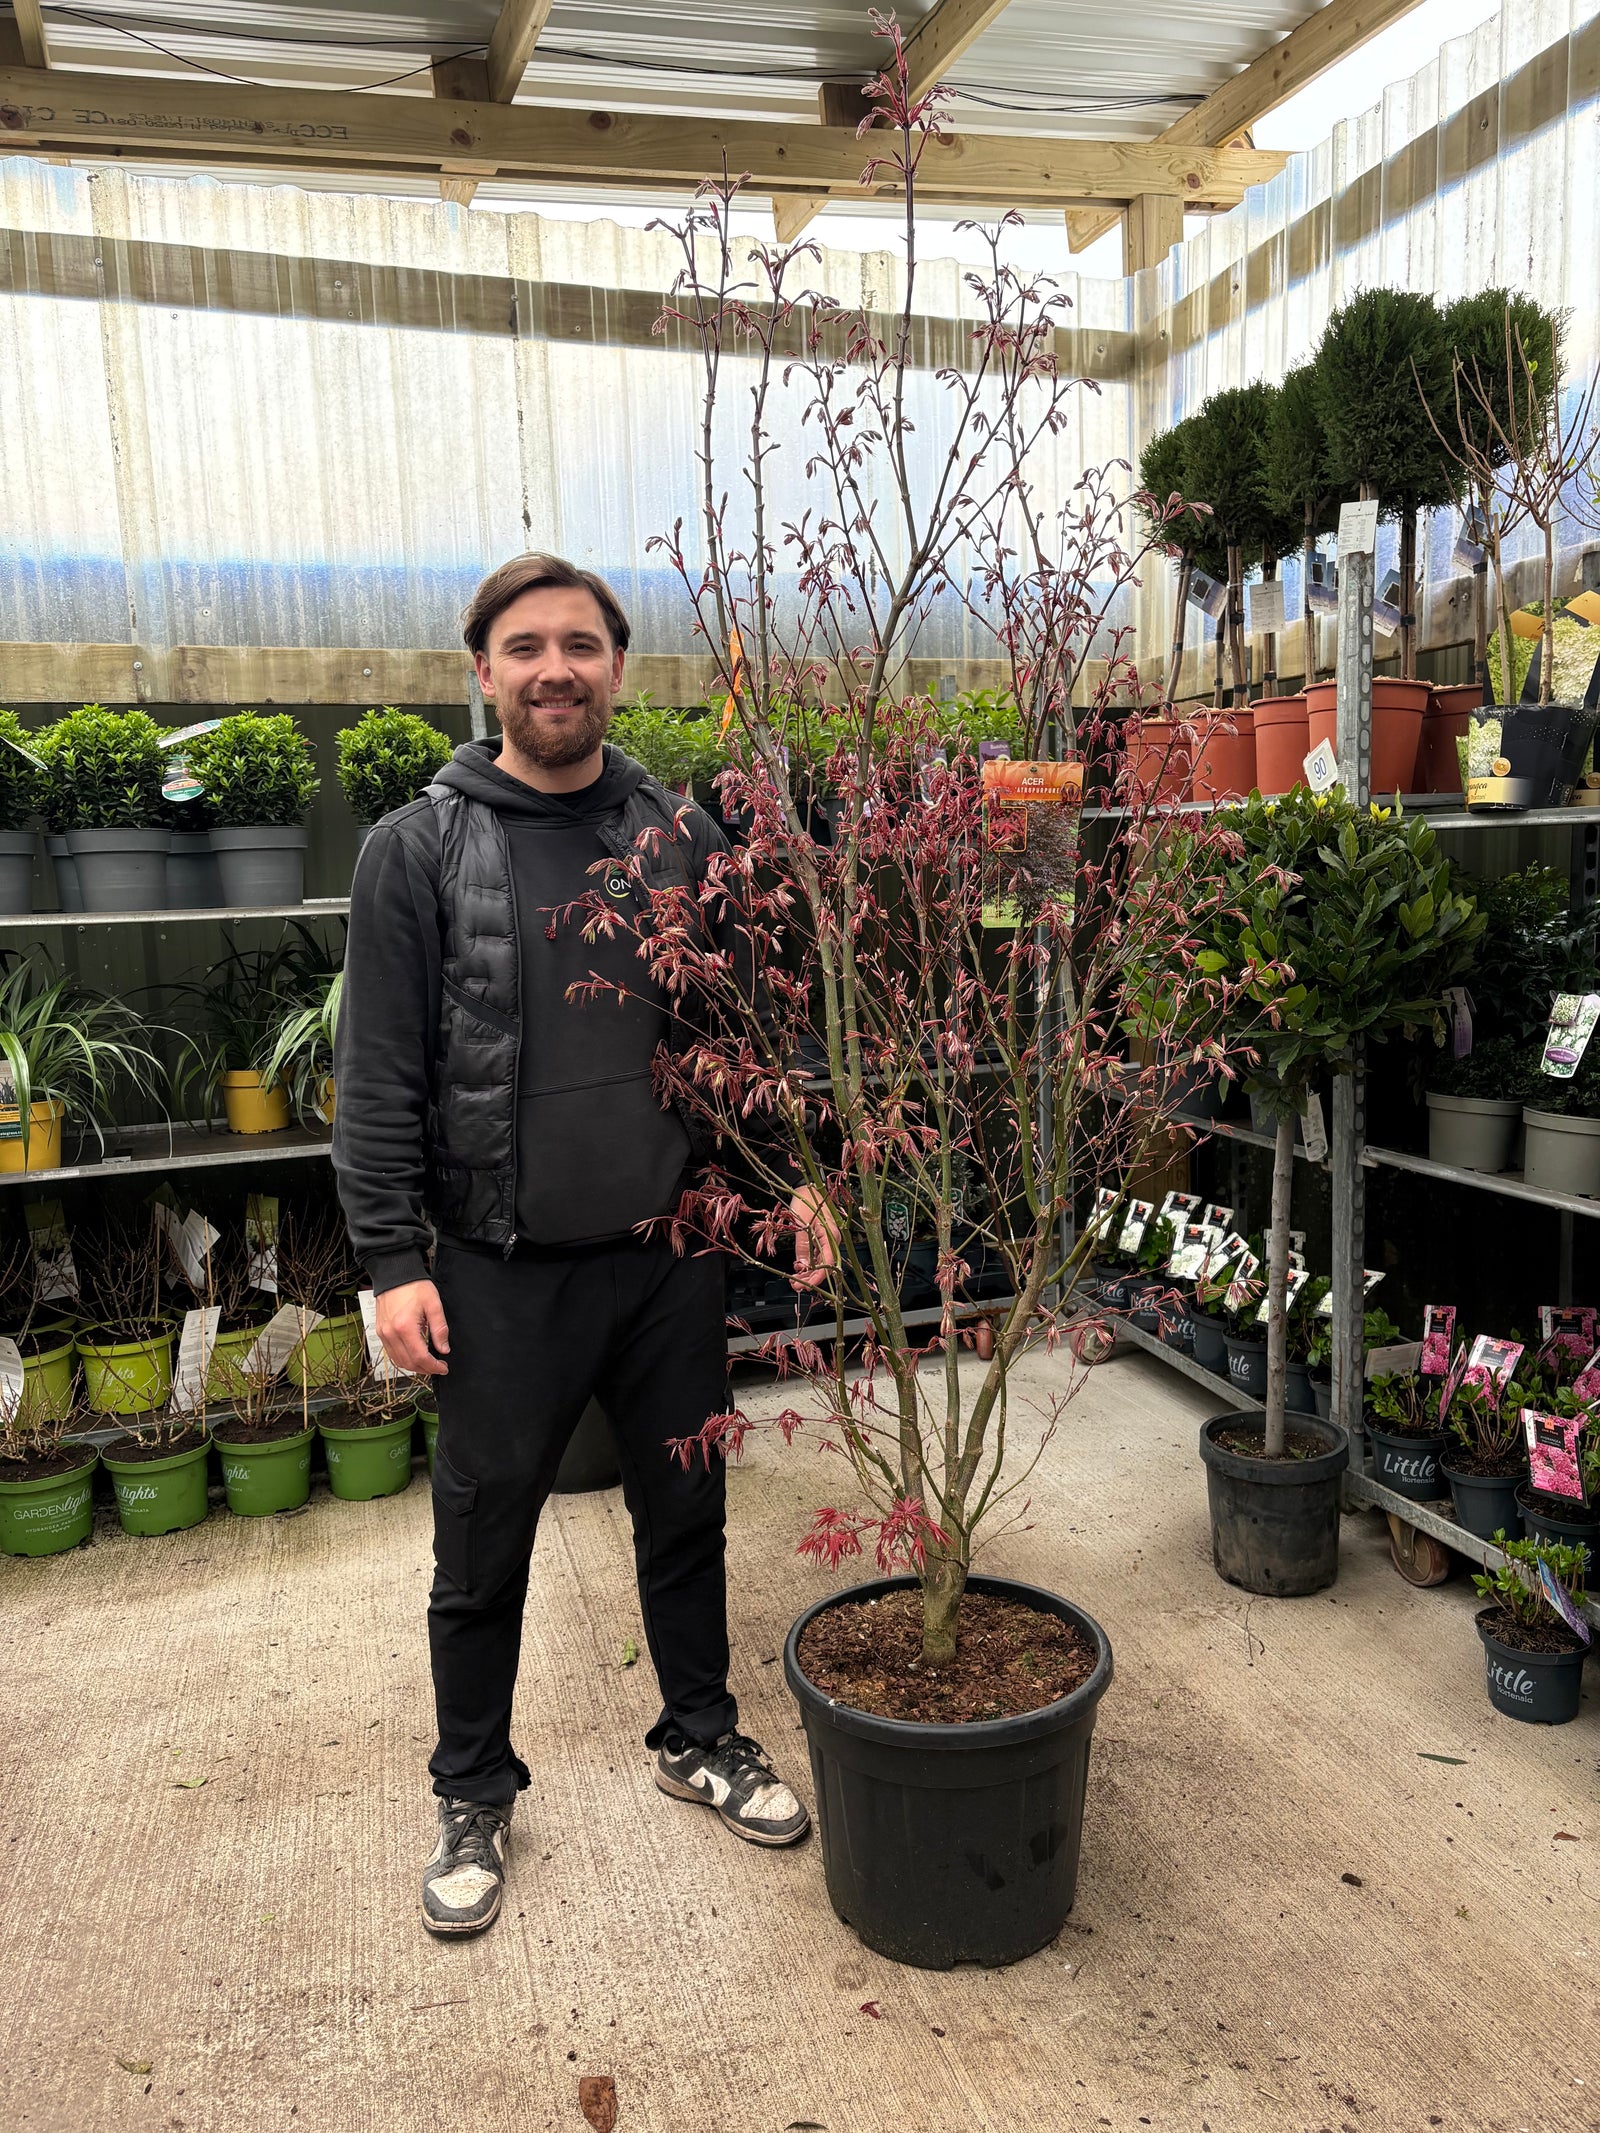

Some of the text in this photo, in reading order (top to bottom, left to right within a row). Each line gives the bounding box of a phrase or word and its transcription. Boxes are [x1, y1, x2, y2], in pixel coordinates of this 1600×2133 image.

[72, 108, 109, 124] CE
[299, 124, 350, 140] ECC
[1314, 757, 1327, 780] 90
[1021, 777, 1045, 786] ACER
[1383, 1453, 1437, 1479] Little
[1402, 1474, 1435, 1484] Hortensia
[1487, 1652, 1535, 1695] Little
